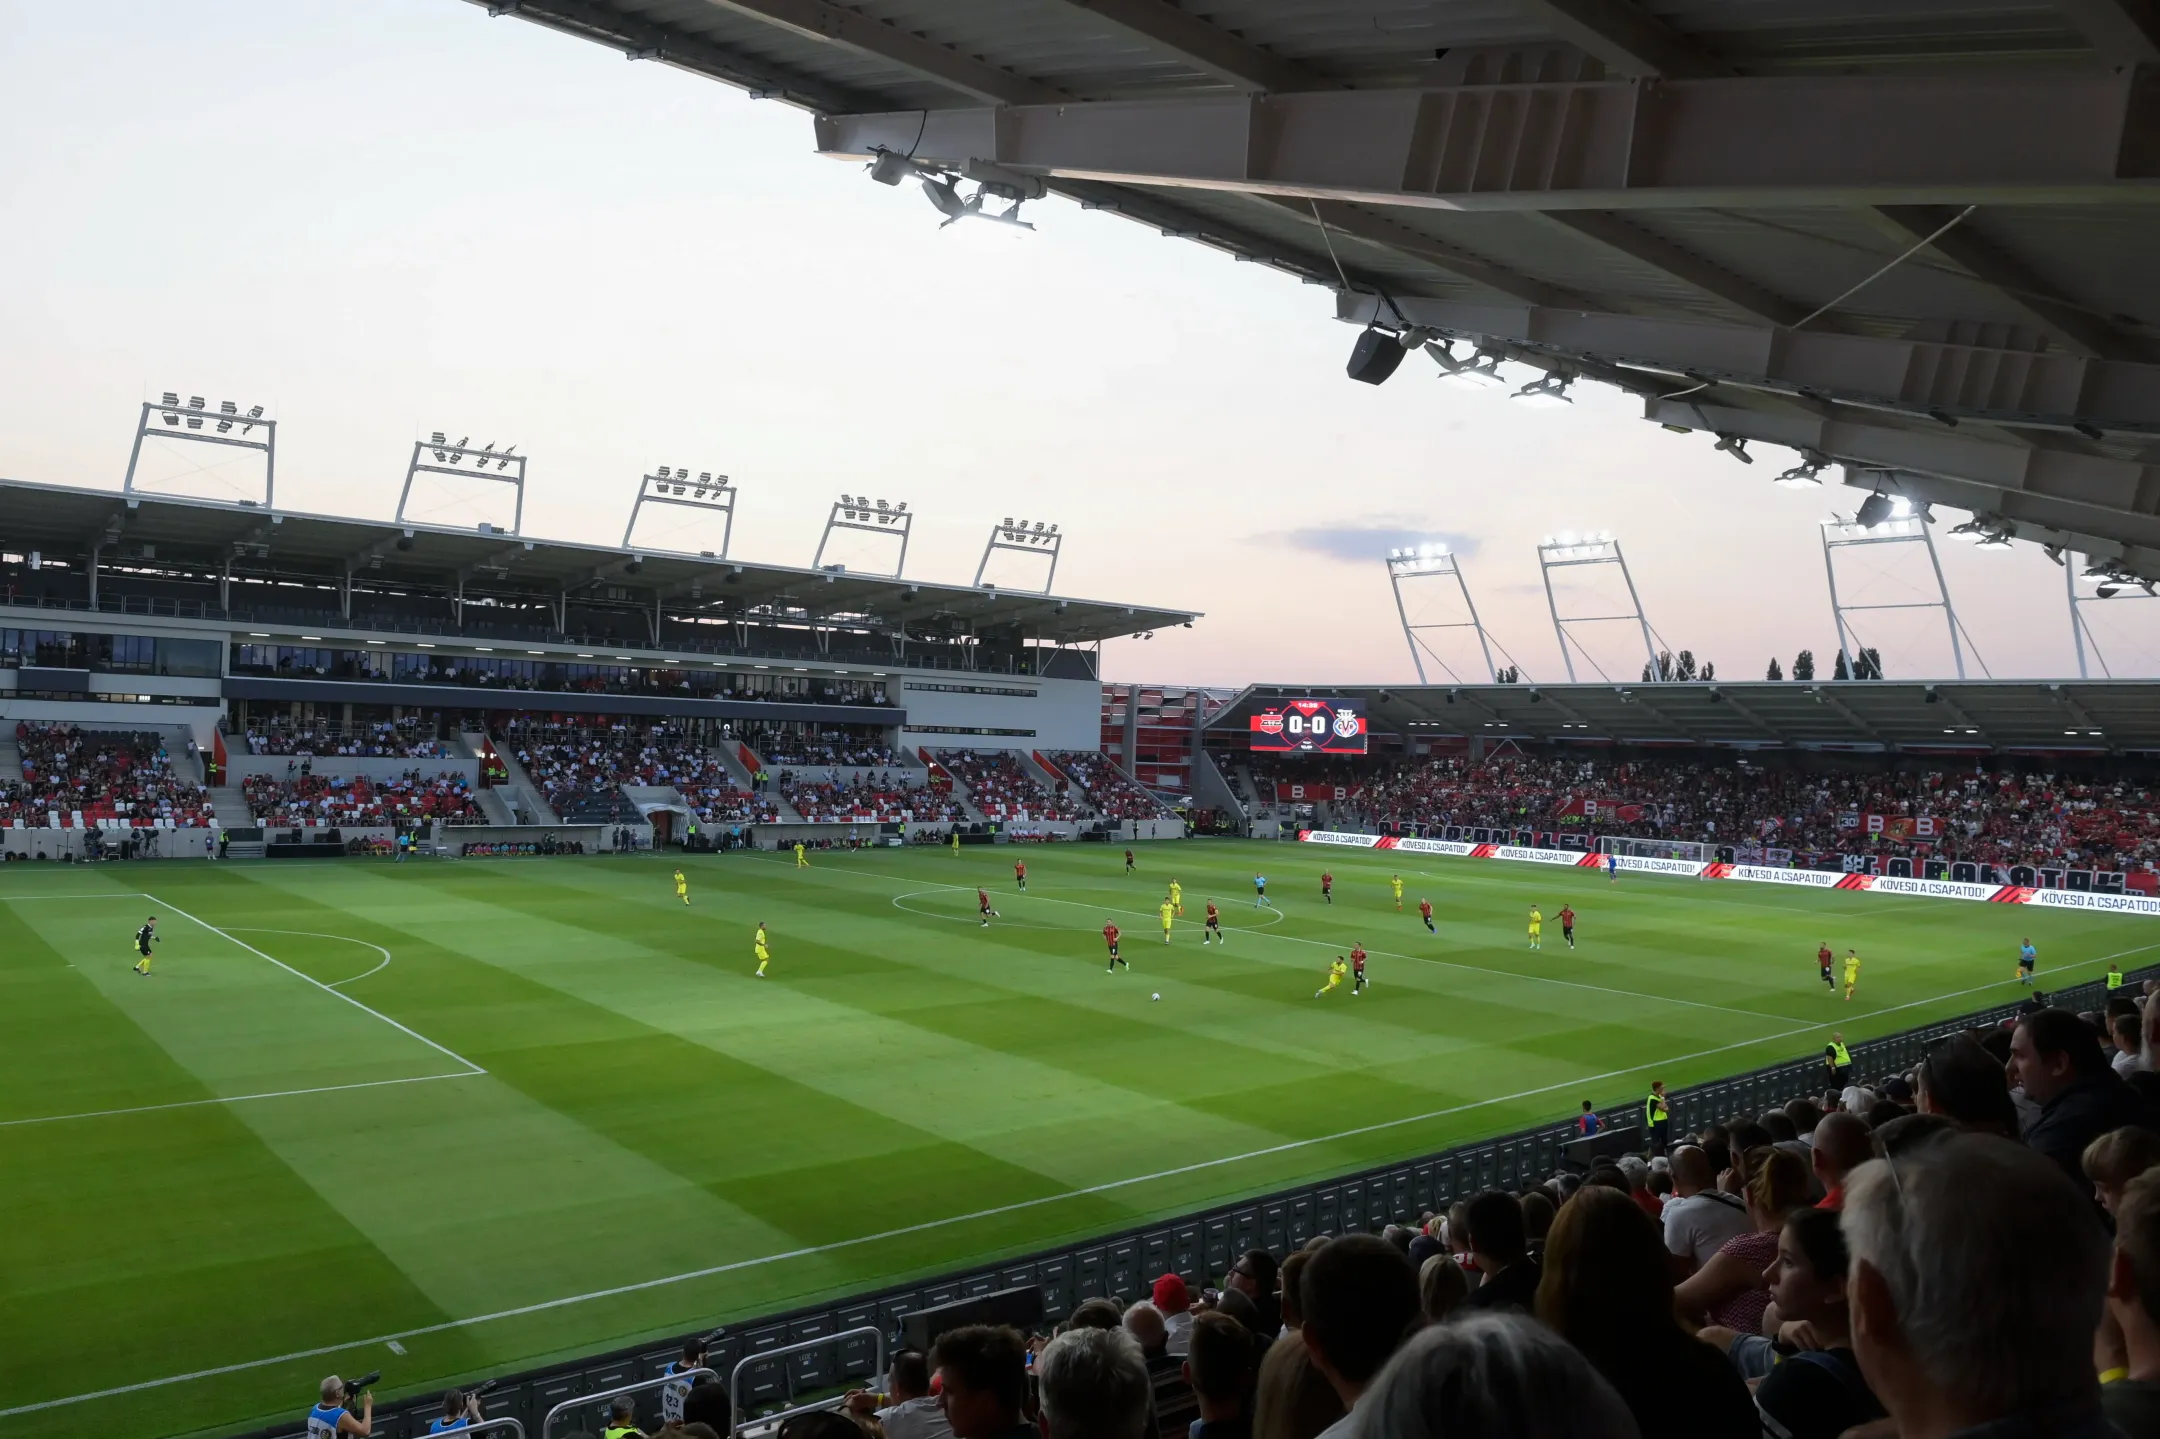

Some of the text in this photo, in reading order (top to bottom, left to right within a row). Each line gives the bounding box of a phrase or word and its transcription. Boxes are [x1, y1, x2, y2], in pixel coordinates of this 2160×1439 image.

[1289, 716, 1326, 734] 0-0
[1841, 818, 1856, 827] 30
[1774, 872, 1780, 880] A
[1782, 872, 1831, 884] CSAPATOD!
[1880, 878, 1985, 898] KÖVESD A CSAPATOD!
[2041, 891, 2084, 906] KÖVESD
[2087, 896, 2095, 907] A
